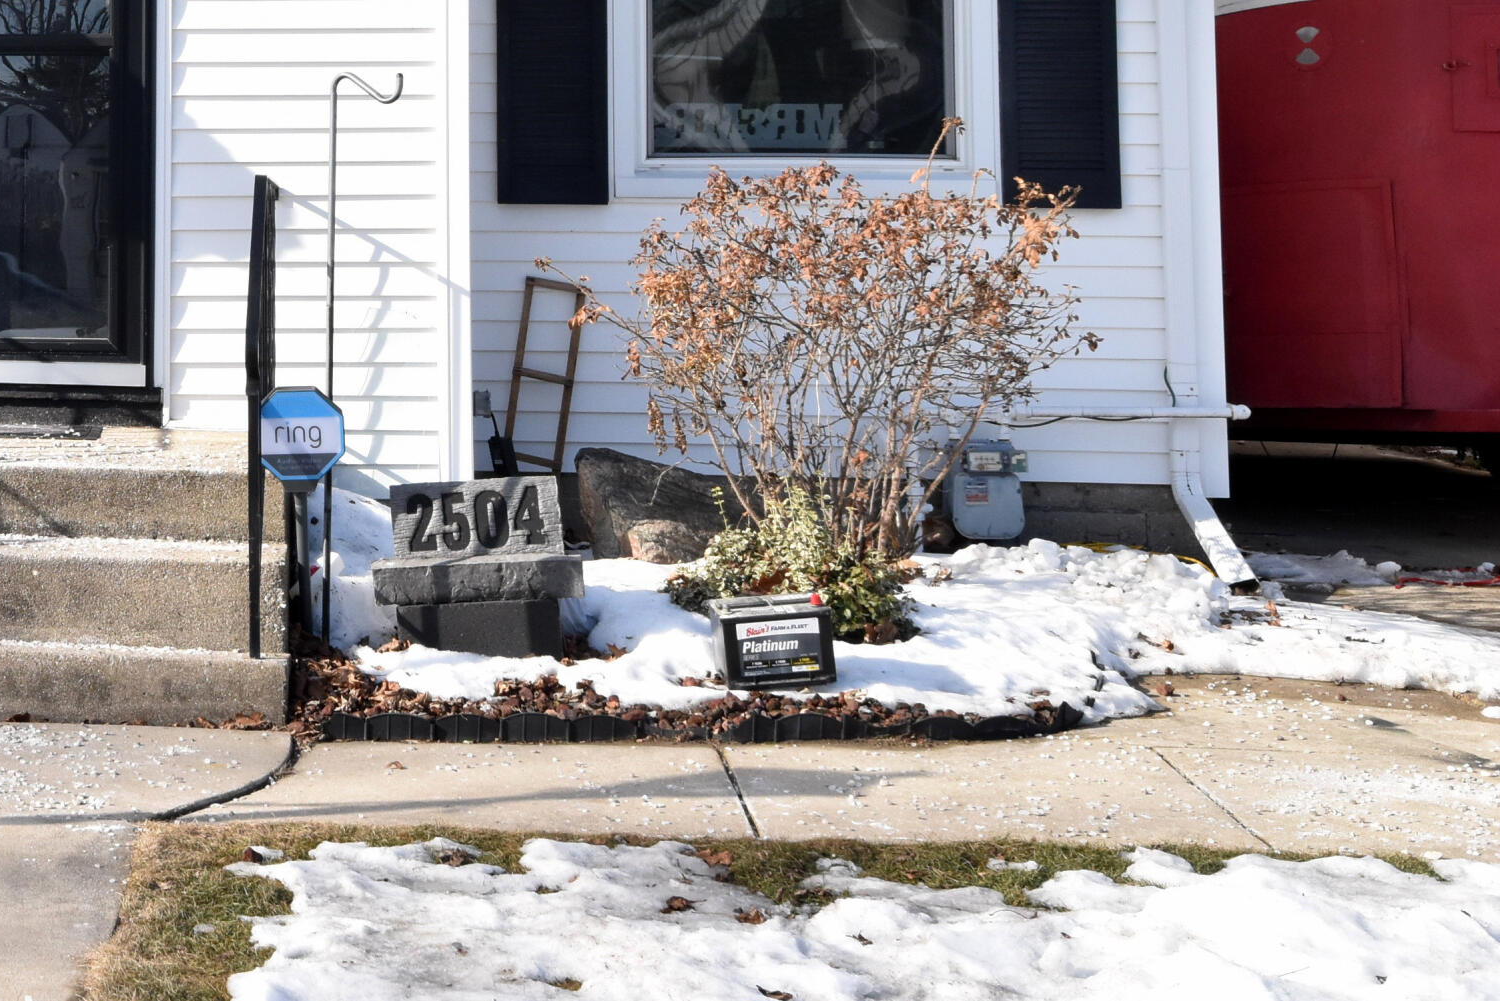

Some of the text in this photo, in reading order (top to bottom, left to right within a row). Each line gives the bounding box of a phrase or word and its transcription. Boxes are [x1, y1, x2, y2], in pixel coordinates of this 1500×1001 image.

[274, 421, 322, 449] ring
[406, 485, 547, 551] 2504
[742, 639, 799, 654] Platinum
